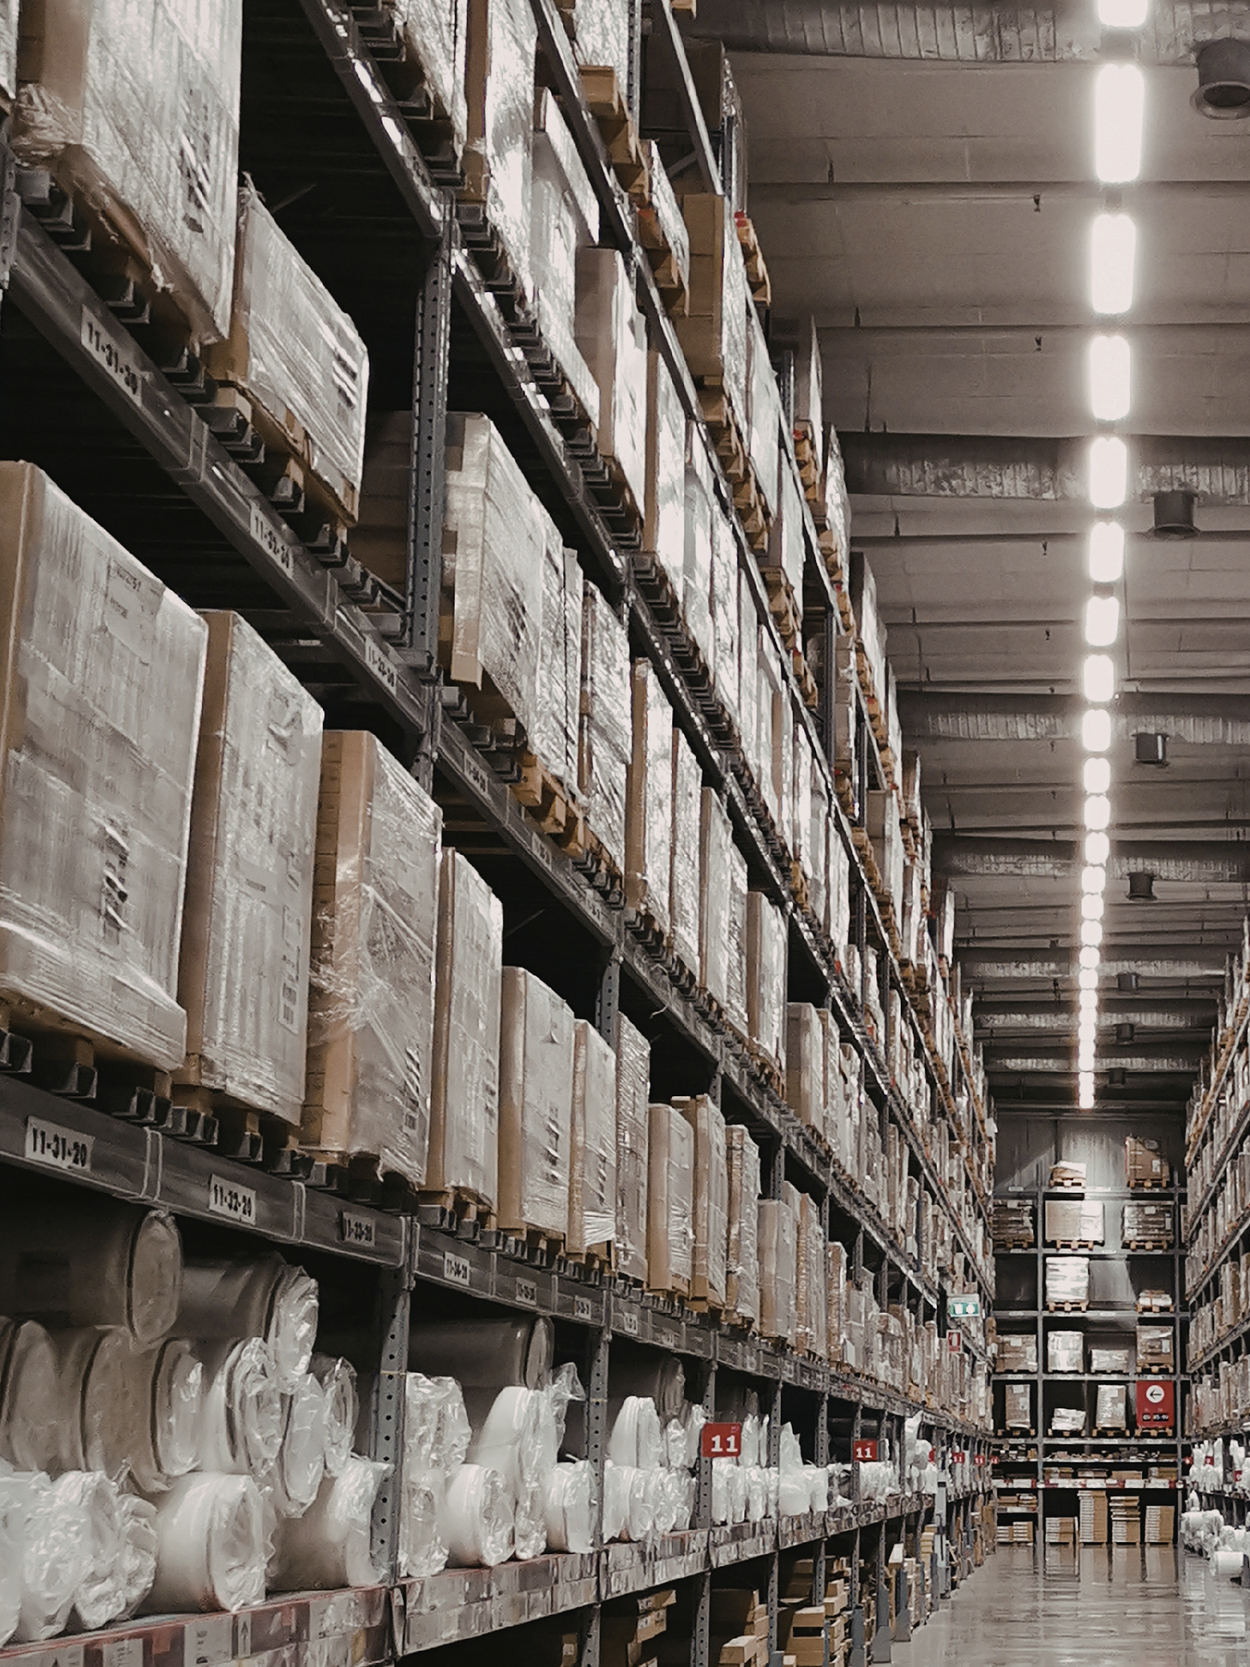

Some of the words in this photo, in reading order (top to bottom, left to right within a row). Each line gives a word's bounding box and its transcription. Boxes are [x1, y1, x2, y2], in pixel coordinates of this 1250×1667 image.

[87, 321, 139, 396] 11-31-30
[32, 1127, 88, 1168] 11-31-20
[213, 1183, 252, 1218] 11-32-20
[710, 1434, 739, 1453] 11
[856, 1446, 873, 1459] 11
